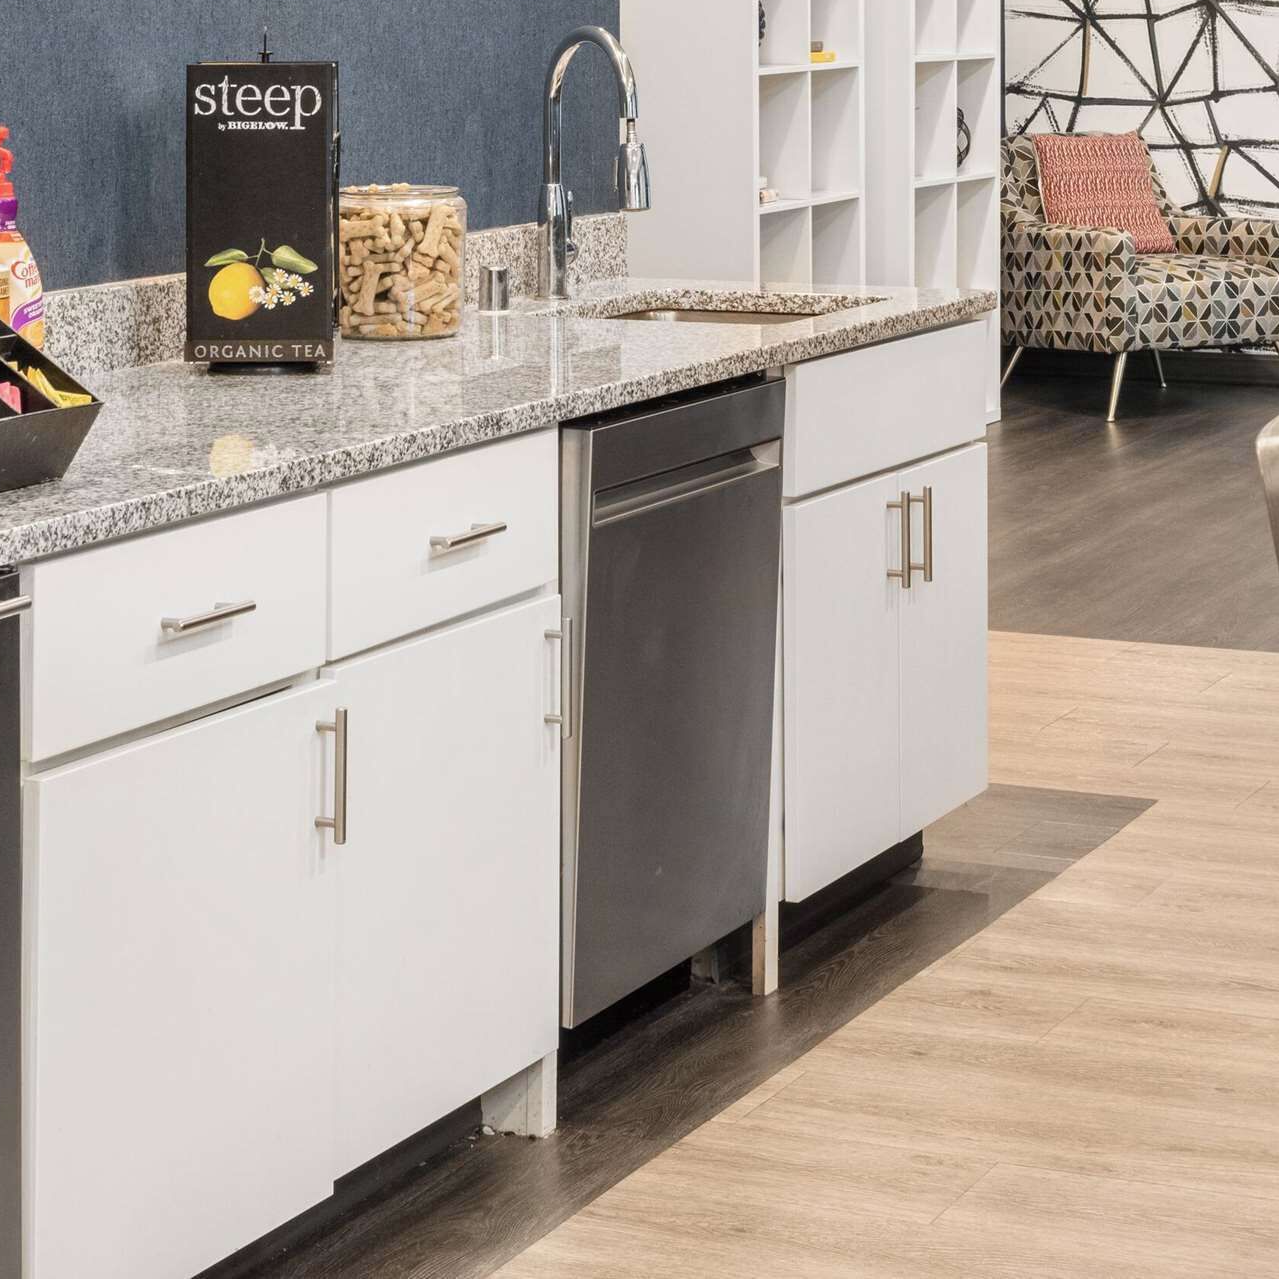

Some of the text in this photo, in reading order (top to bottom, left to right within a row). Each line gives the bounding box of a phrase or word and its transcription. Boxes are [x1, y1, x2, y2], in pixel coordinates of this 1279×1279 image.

[194, 75, 322, 130] steep
[218, 122, 227, 131] by
[194, 344, 326, 358] ORGANIC TEA
